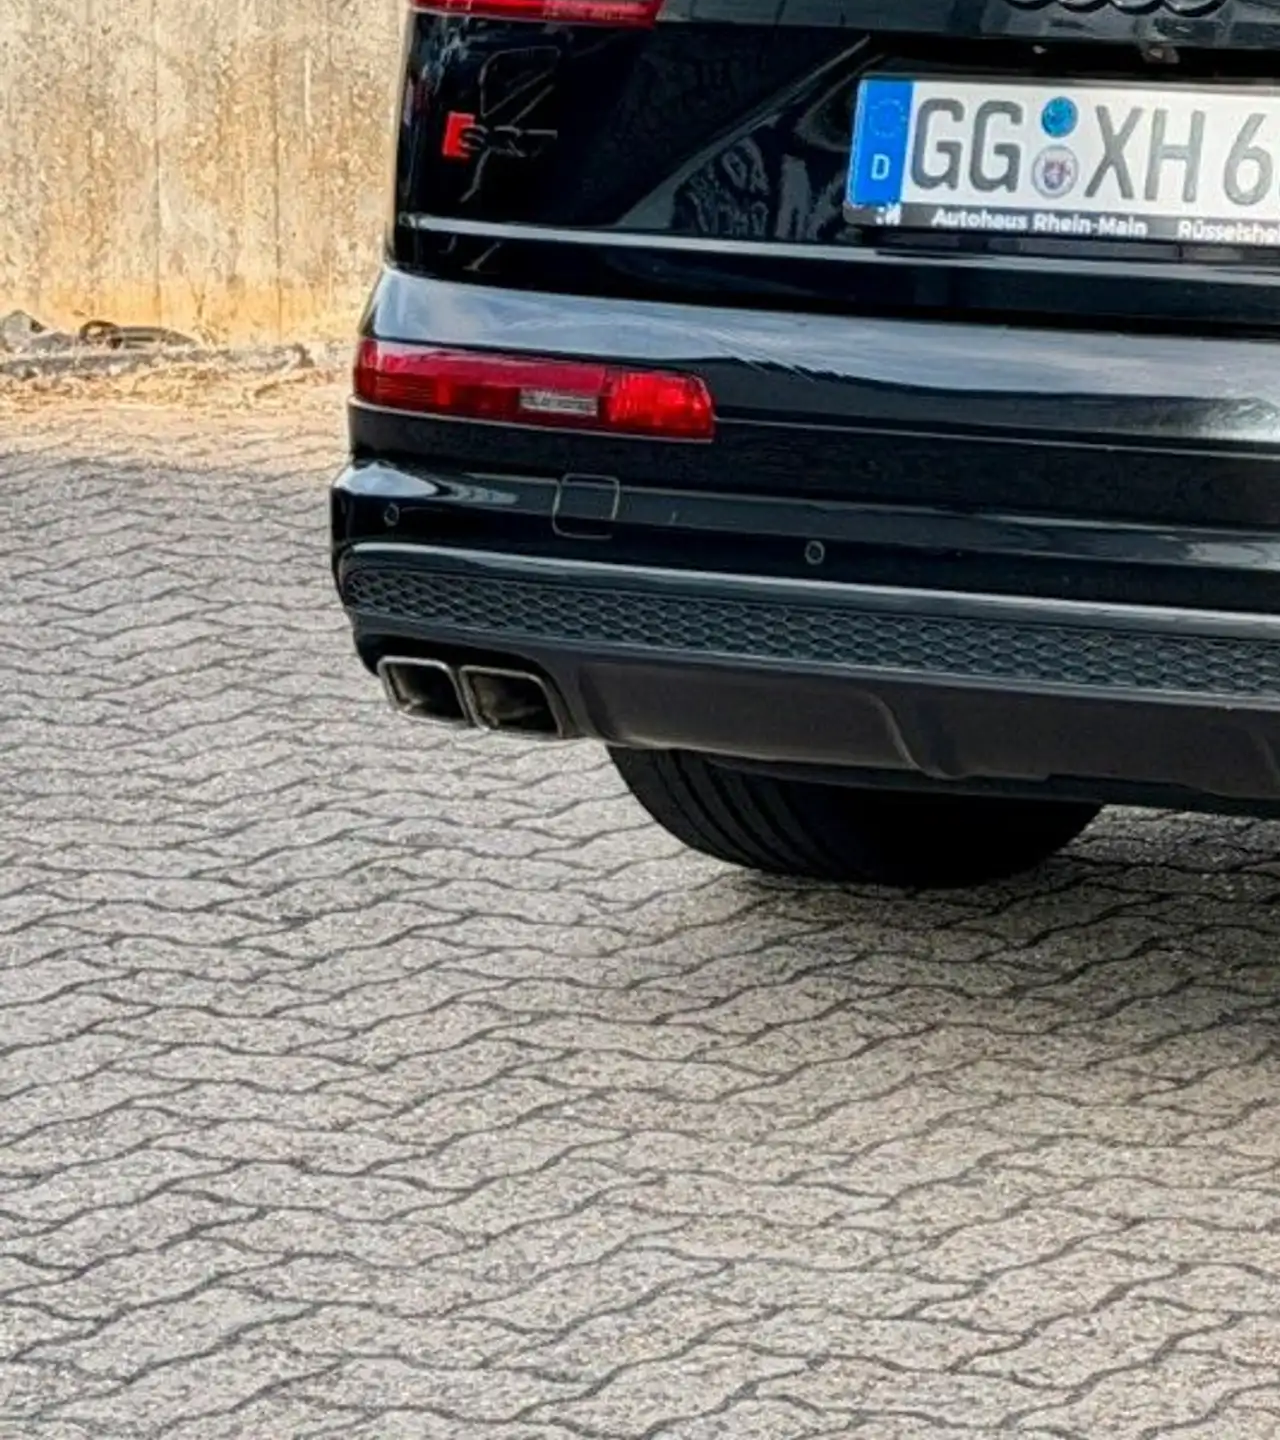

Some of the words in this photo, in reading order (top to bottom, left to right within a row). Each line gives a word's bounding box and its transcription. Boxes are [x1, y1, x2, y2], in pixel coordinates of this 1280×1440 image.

[870, 154, 890, 181] D
[909, 97, 1023, 195] GG
[1083, 104, 1207, 203] XH
[931, 207, 1027, 233] Autohaus
[1031, 213, 1147, 238] Rhein-Main
